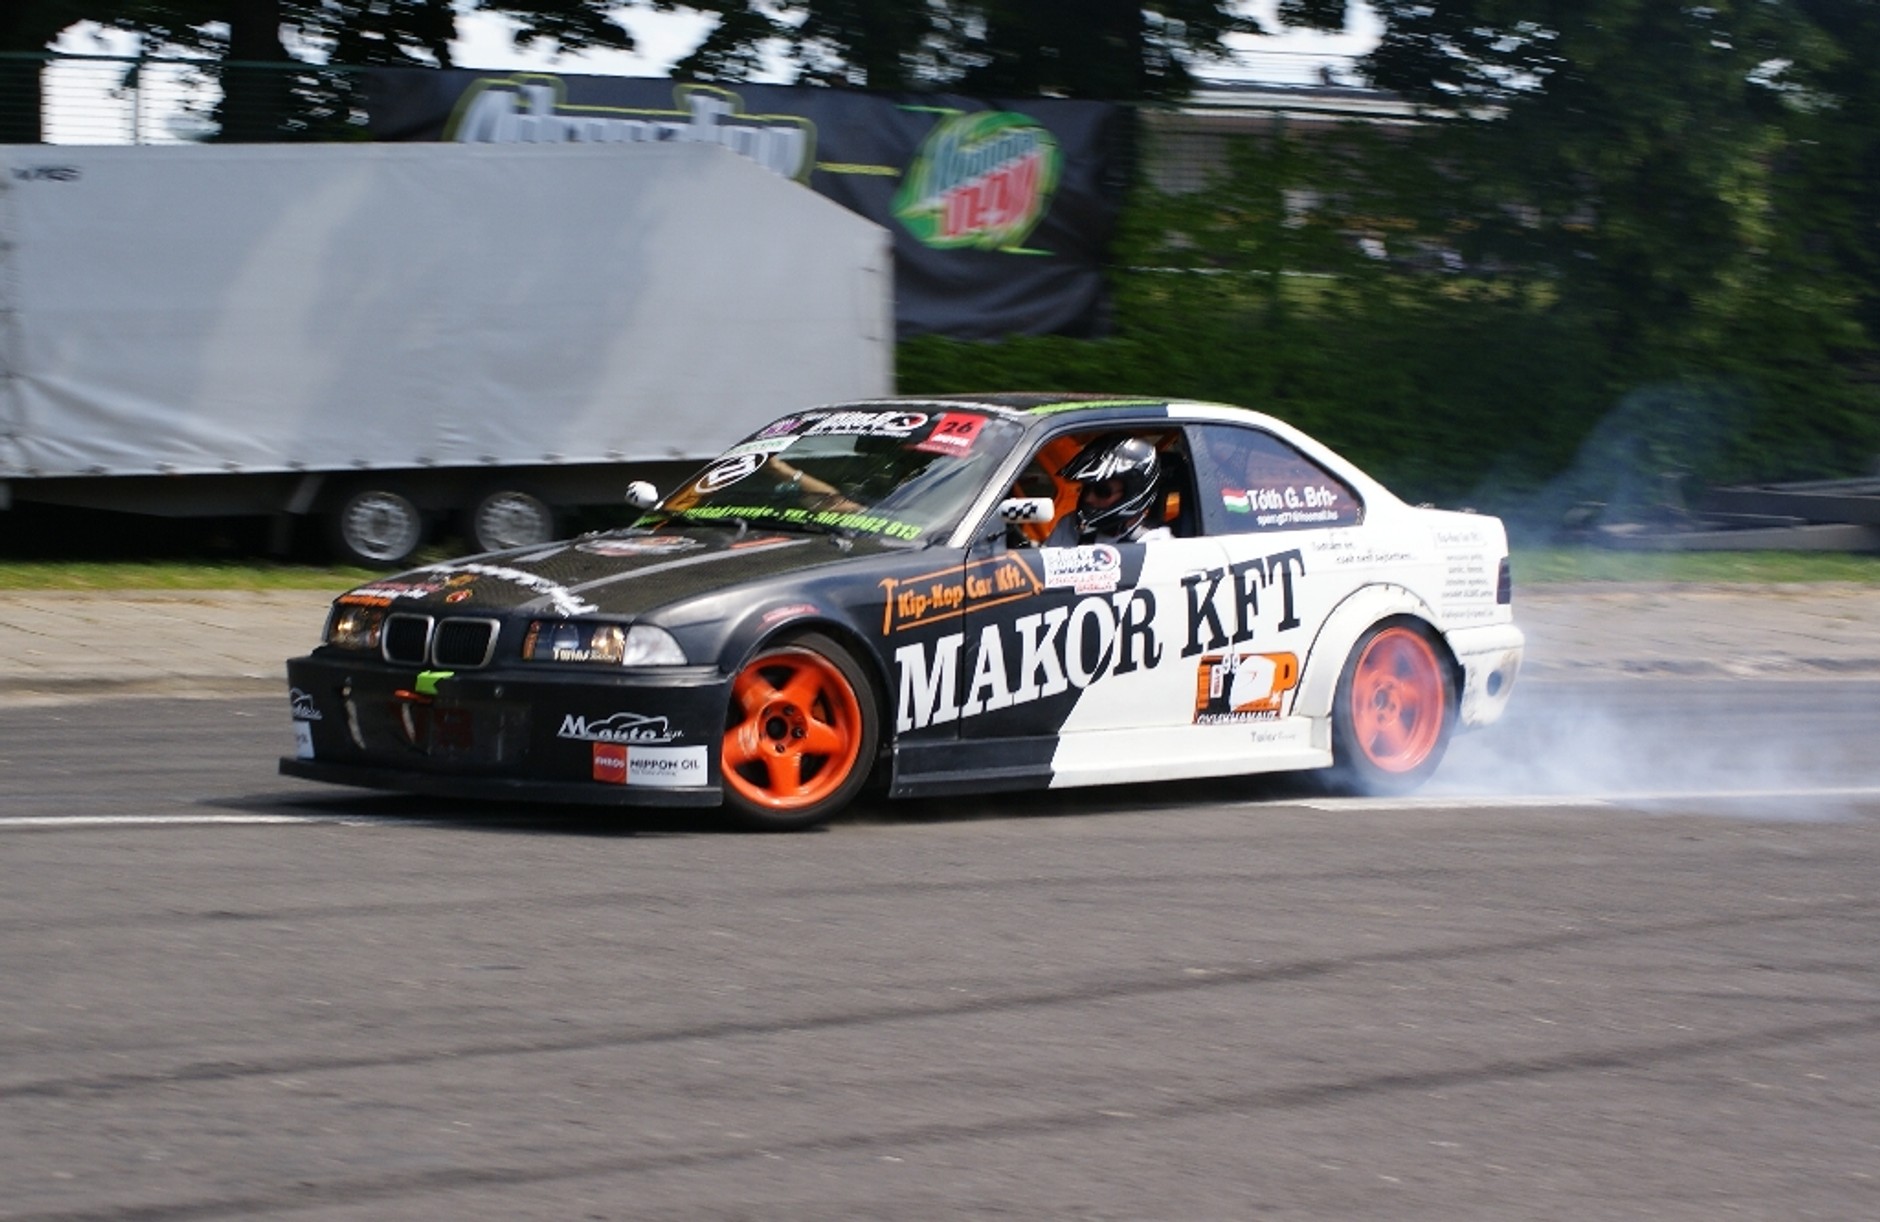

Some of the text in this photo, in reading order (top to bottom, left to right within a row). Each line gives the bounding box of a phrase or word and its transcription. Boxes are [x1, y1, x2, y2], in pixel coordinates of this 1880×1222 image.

[942, 421, 974, 434] 26
[1246, 486, 1283, 511] Tóth
[1284, 486, 1304, 509] G.
[966, 575, 992, 599] Car
[995, 563, 1026, 592] Kft.
[894, 549, 1306, 734] MAKOR KFT
[630, 759, 700, 770] NIPPON OIL
